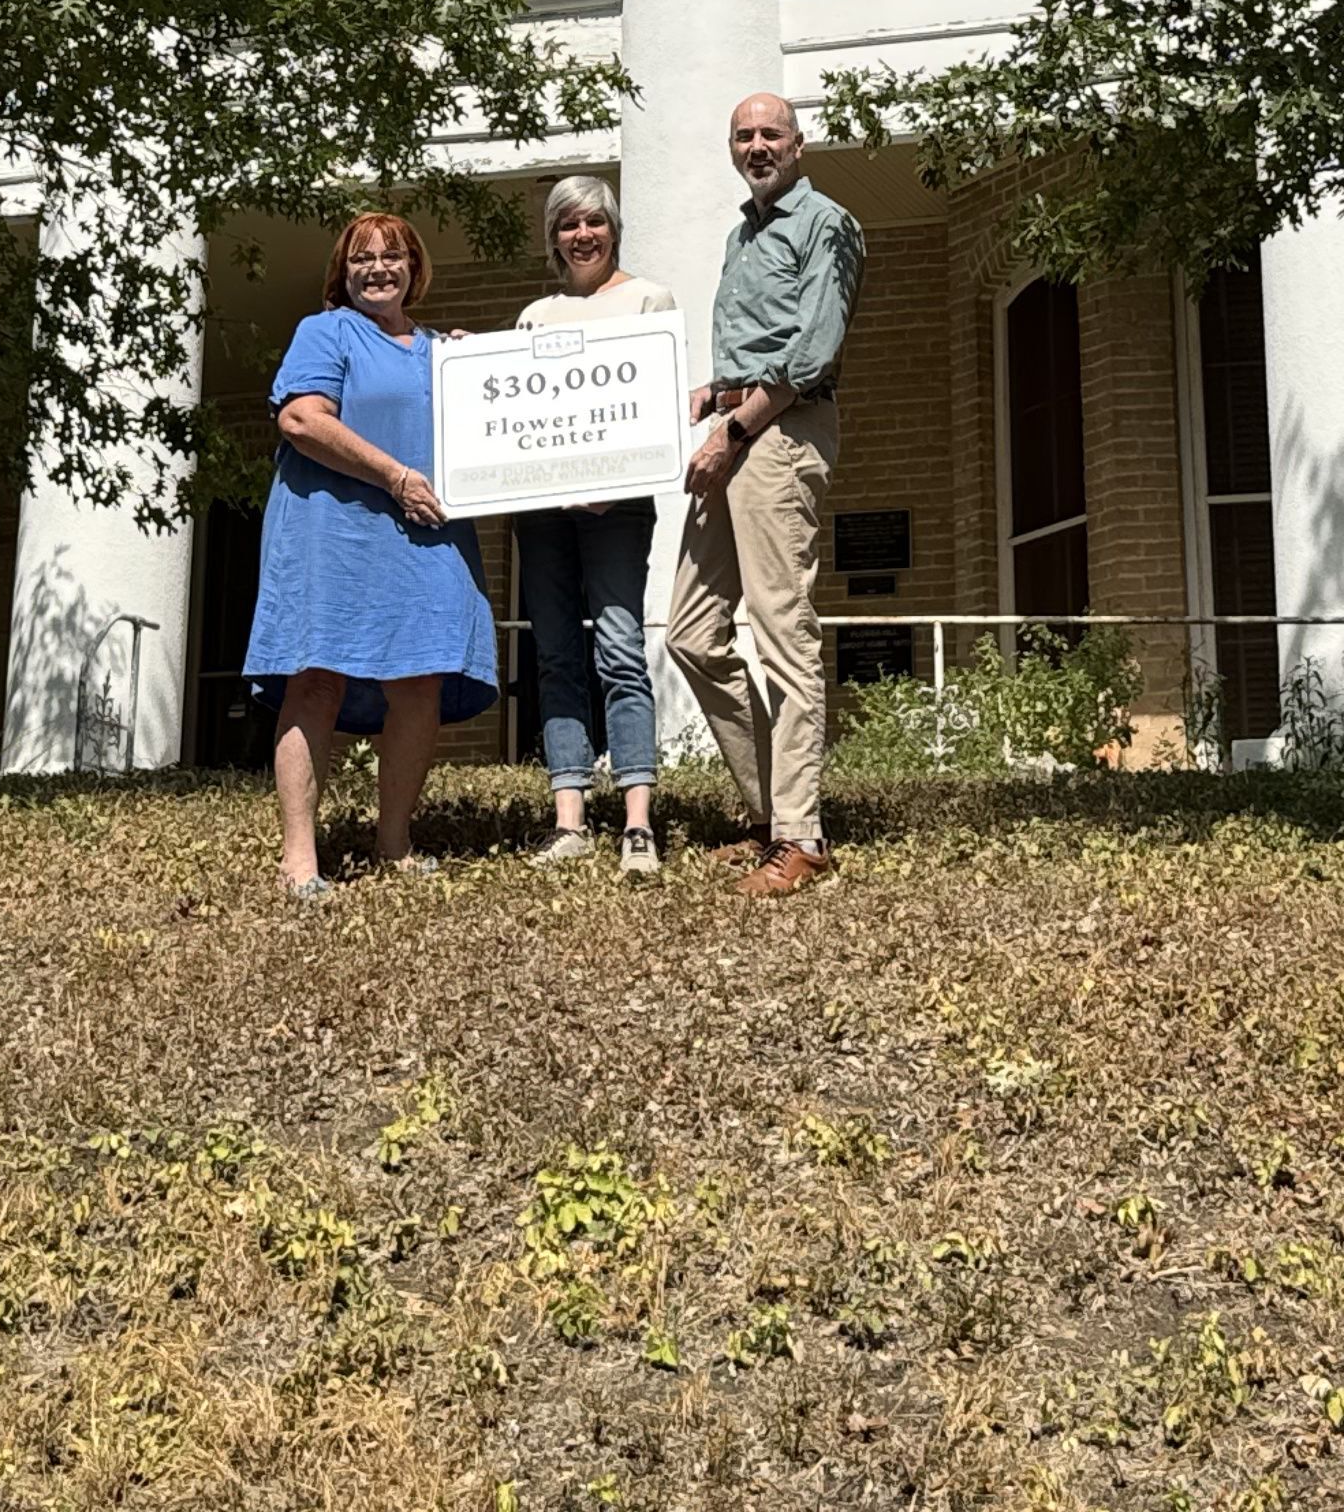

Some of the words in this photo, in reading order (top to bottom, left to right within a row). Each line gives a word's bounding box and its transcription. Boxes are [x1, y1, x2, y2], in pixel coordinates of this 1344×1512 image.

[483, 361, 637, 404] $30,000
[485, 414, 578, 437] Flower
[590, 401, 639, 425] Hill
[517, 427, 608, 451] Center
[461, 468, 498, 483] 2024
[550, 448, 666, 471] PRESERVATION
